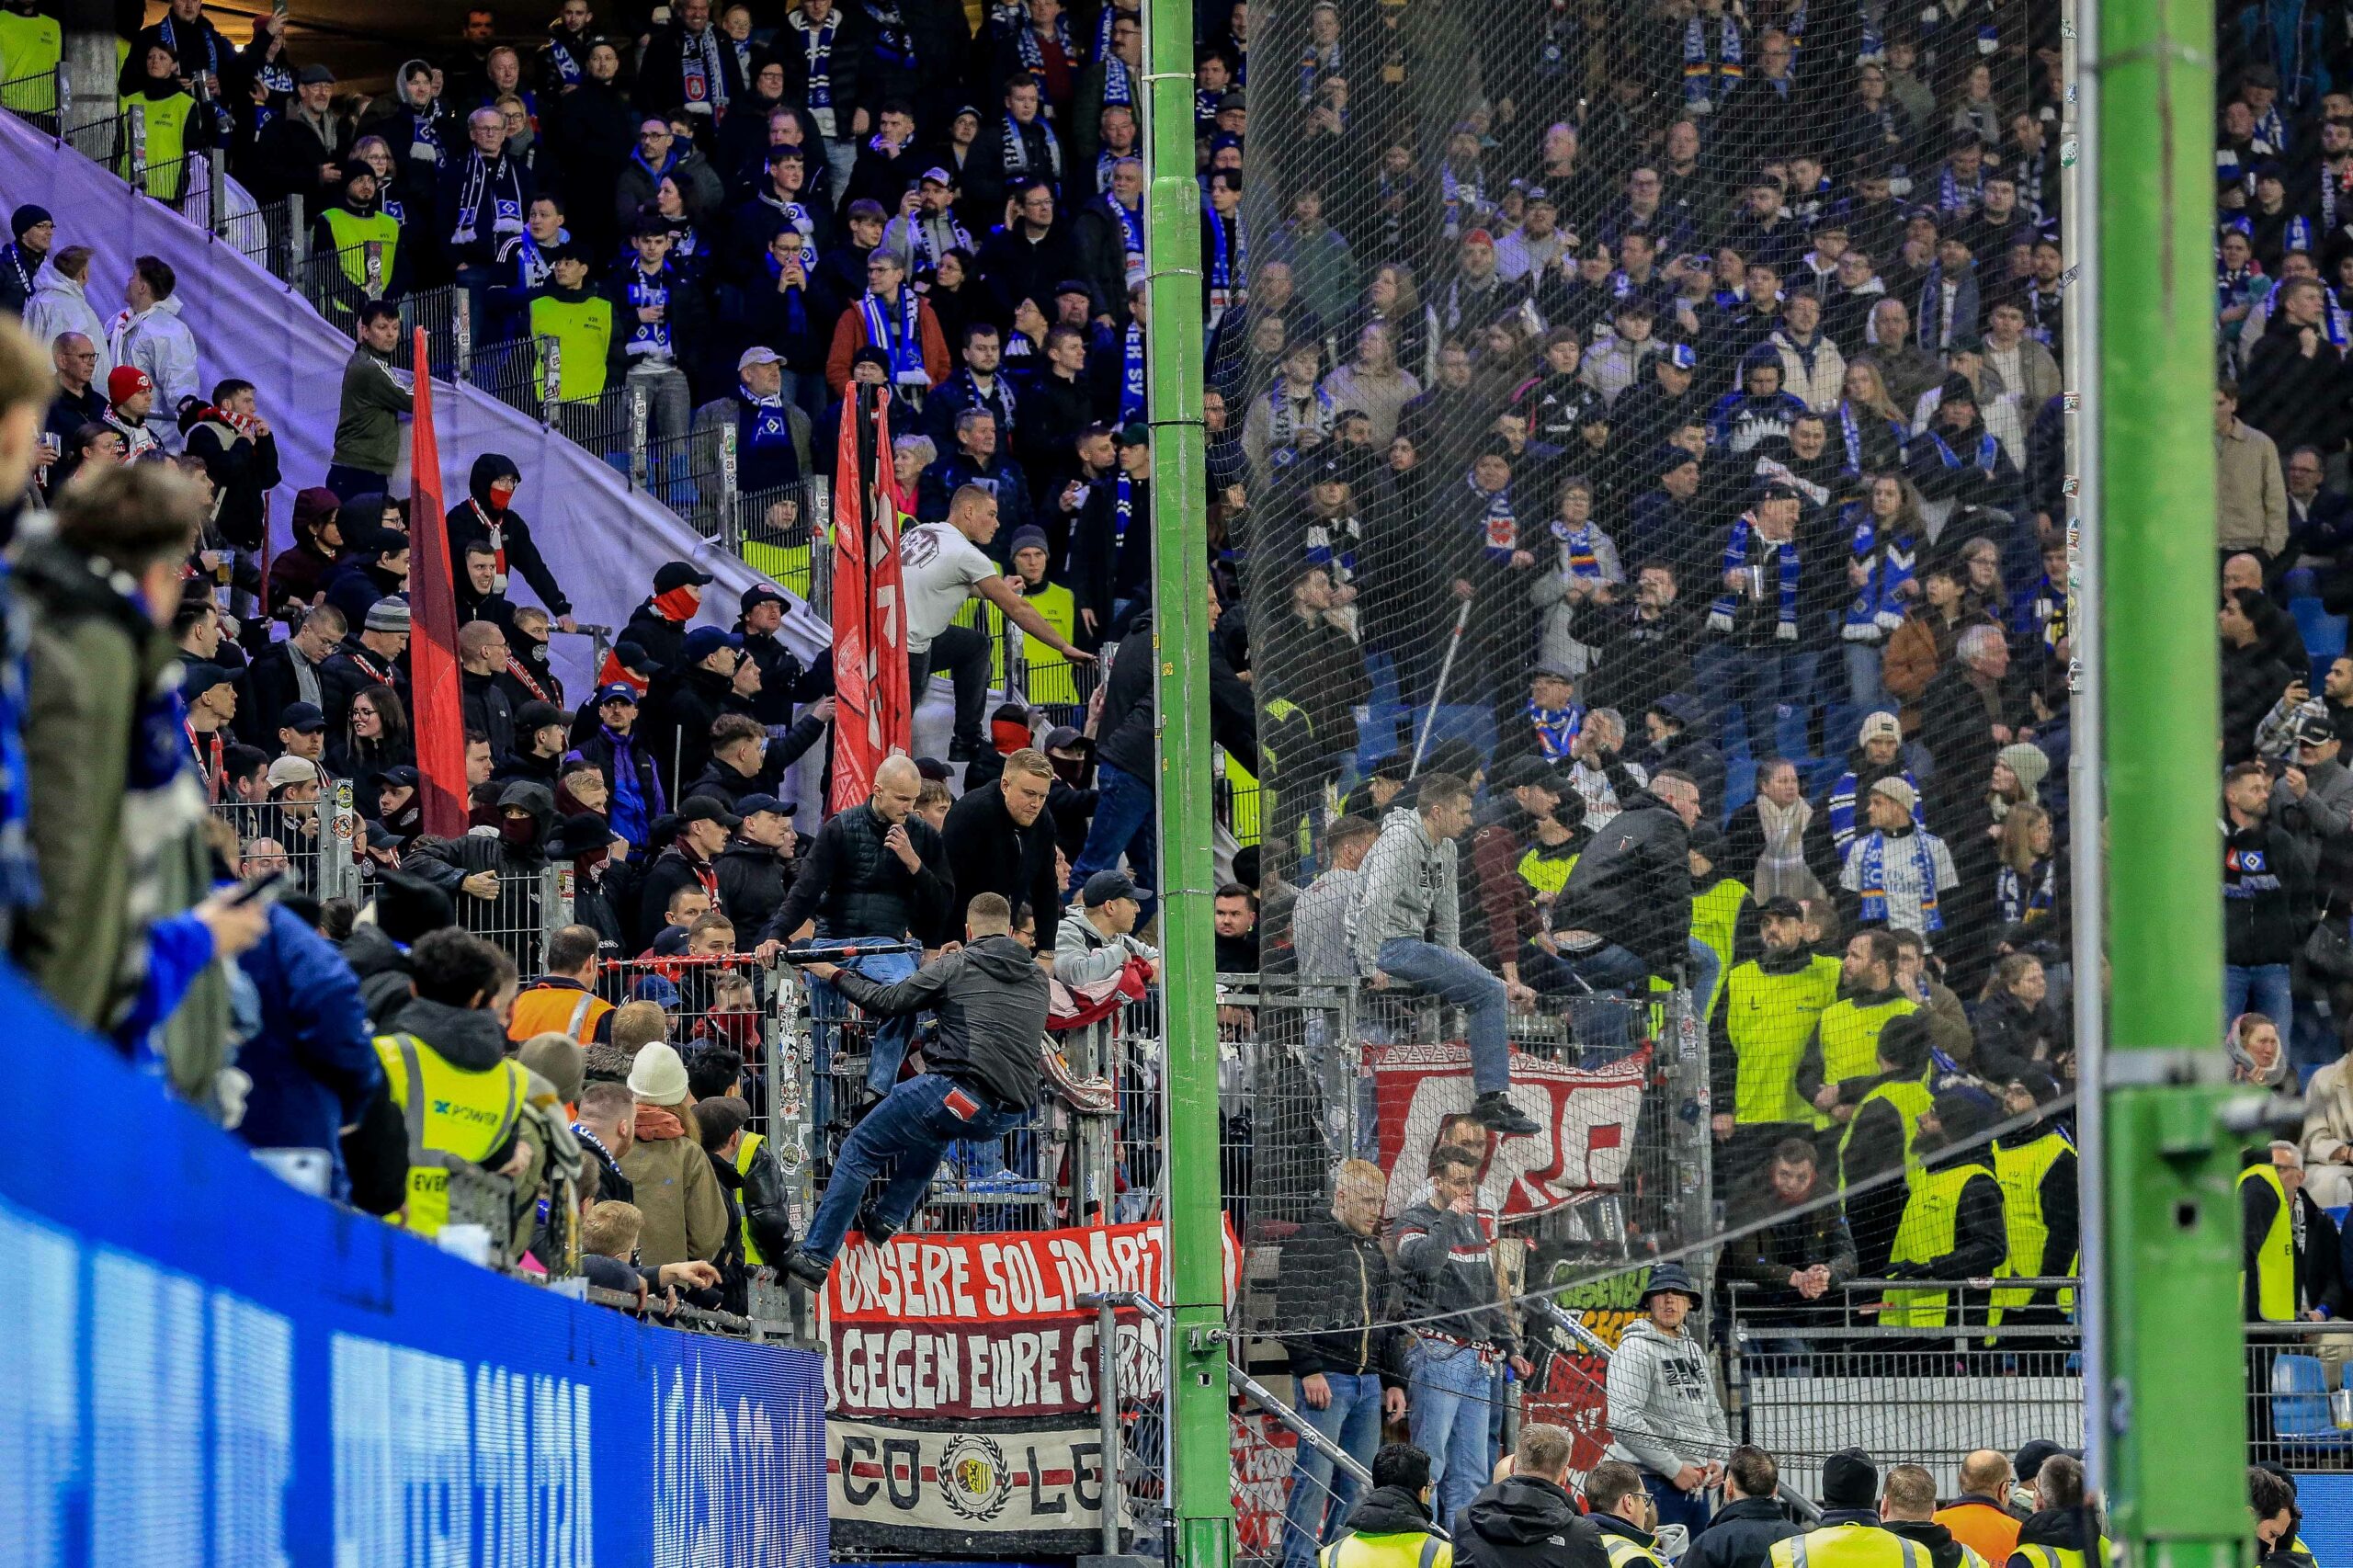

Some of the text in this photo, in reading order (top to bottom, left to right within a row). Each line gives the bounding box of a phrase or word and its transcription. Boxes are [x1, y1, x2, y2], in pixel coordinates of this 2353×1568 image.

[820, 498, 828, 506] 29
[835, 1241, 978, 1318] UNSERE
[841, 1327, 961, 1409] GEGEN
[970, 1329, 1063, 1409] EURE
[842, 1436, 920, 1511] CO
